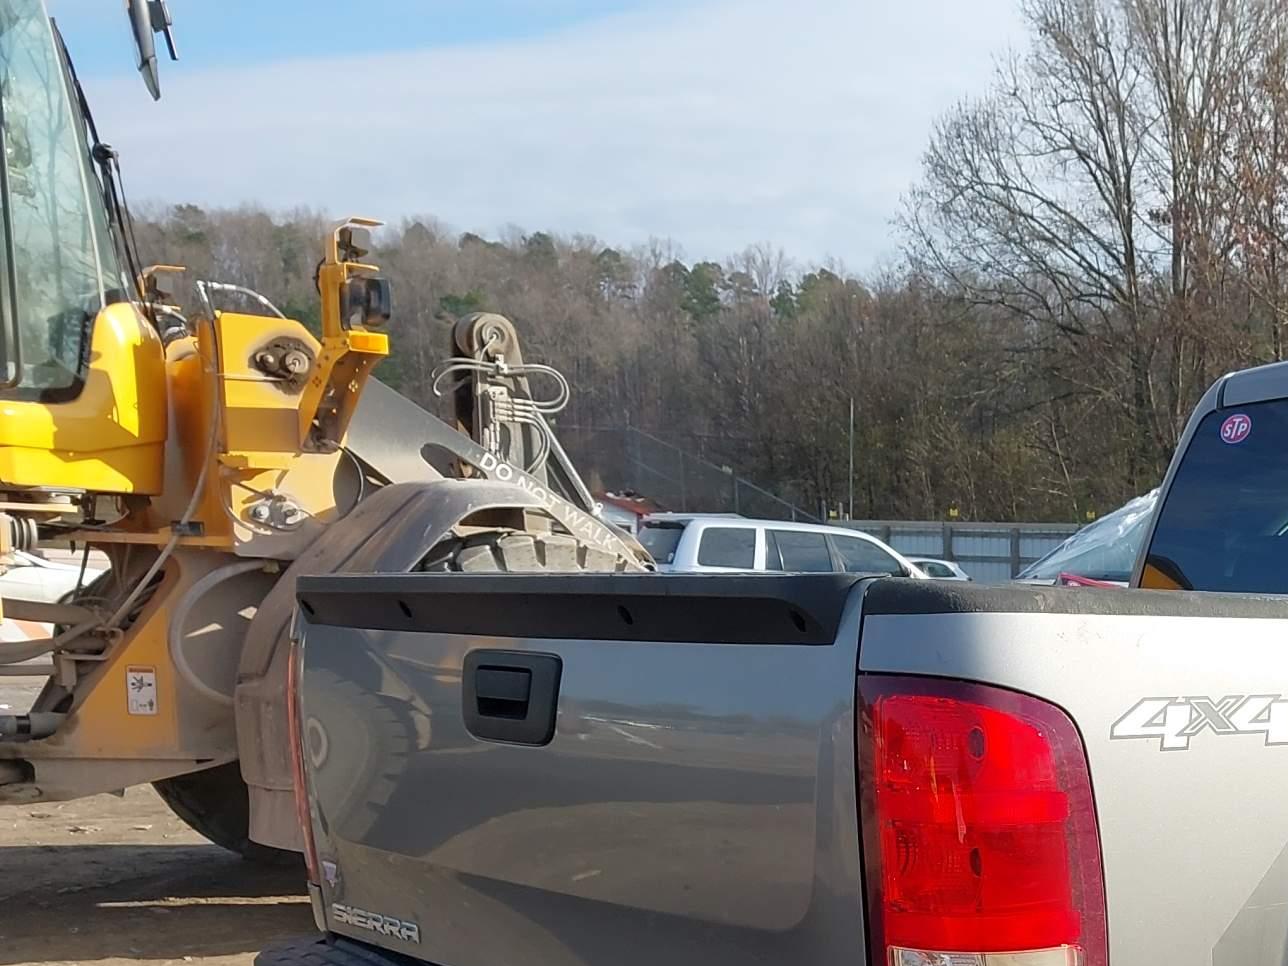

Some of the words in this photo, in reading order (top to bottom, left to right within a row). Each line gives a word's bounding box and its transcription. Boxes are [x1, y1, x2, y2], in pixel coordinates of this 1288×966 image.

[1223, 417, 1248, 439] STP
[479, 452, 513, 481] DO
[516, 475, 561, 512] NOT
[563, 505, 617, 551] WALK
[332, 903, 420, 944] SIERRA
